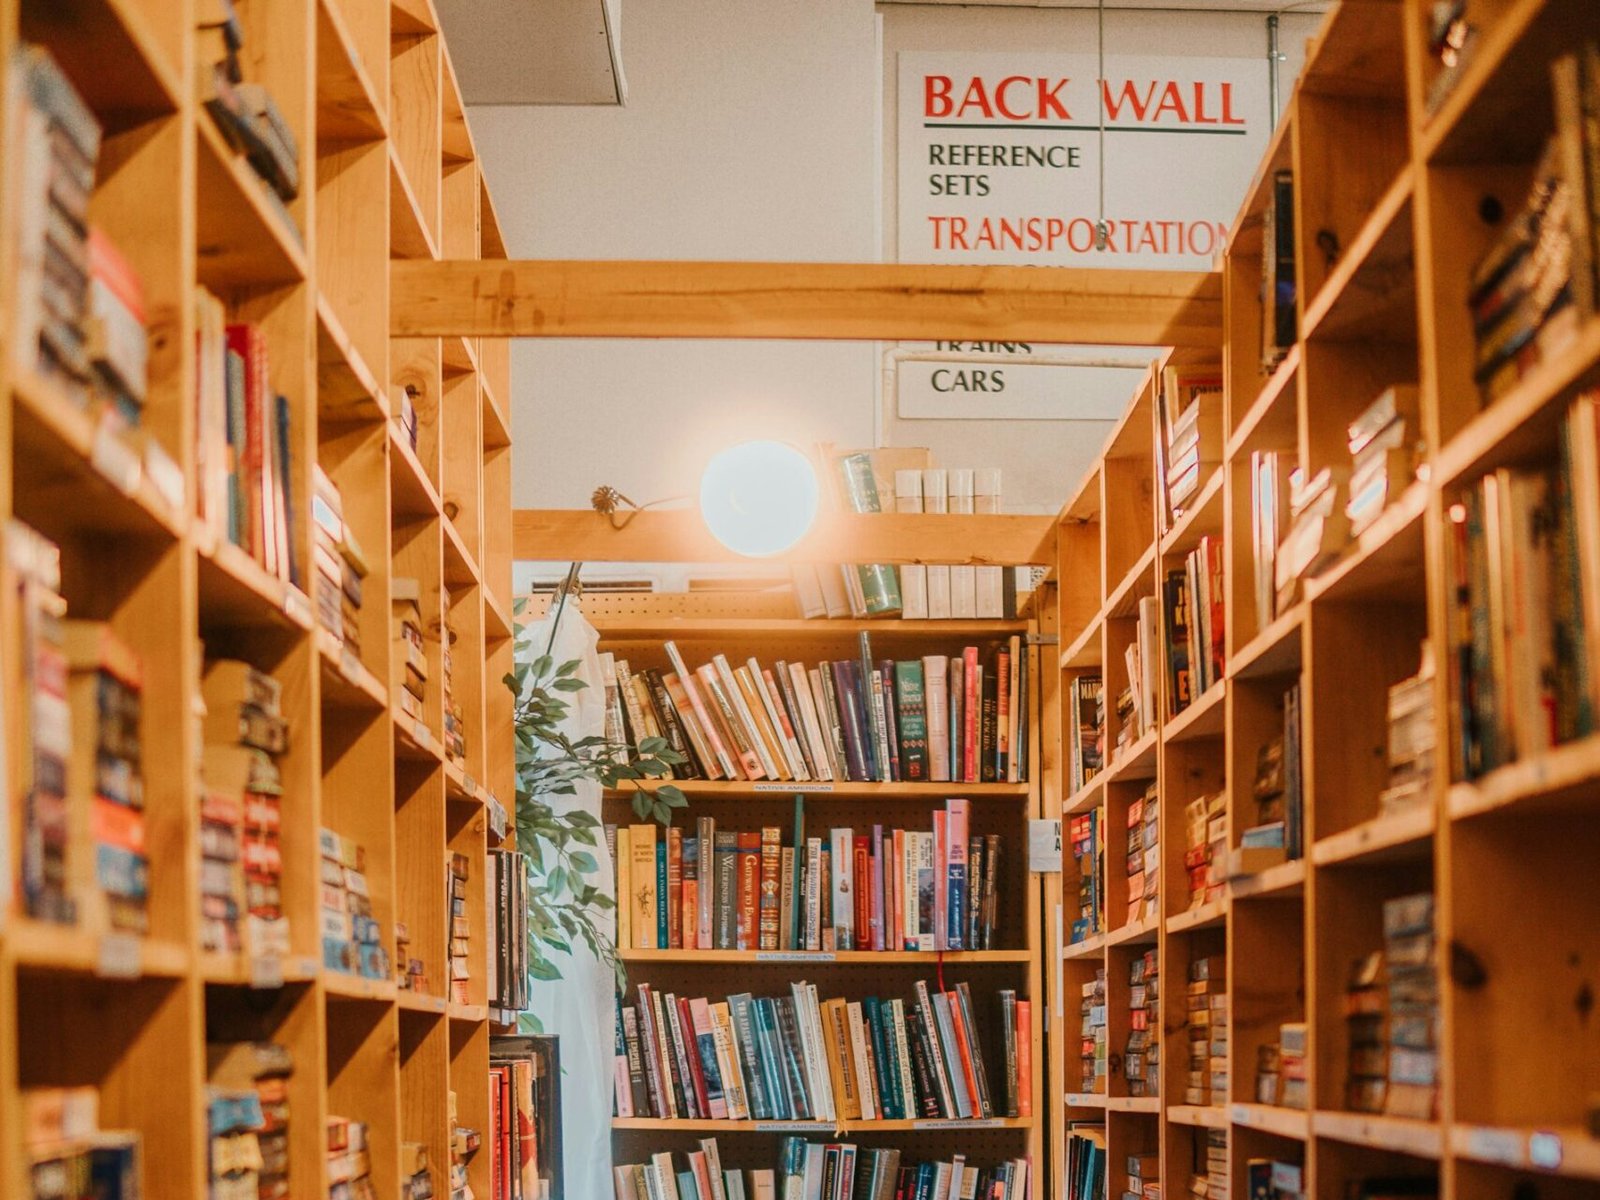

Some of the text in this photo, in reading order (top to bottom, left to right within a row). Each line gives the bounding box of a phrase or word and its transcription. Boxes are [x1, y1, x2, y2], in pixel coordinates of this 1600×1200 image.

[923, 75, 1246, 125] BACK WALL
[928, 144, 1081, 168] REFERENCE
[928, 174, 990, 197] SETS
[931, 369, 1005, 392] CARS
[744, 854, 757, 892] GATEWAY
[745, 895, 752, 905] TO
